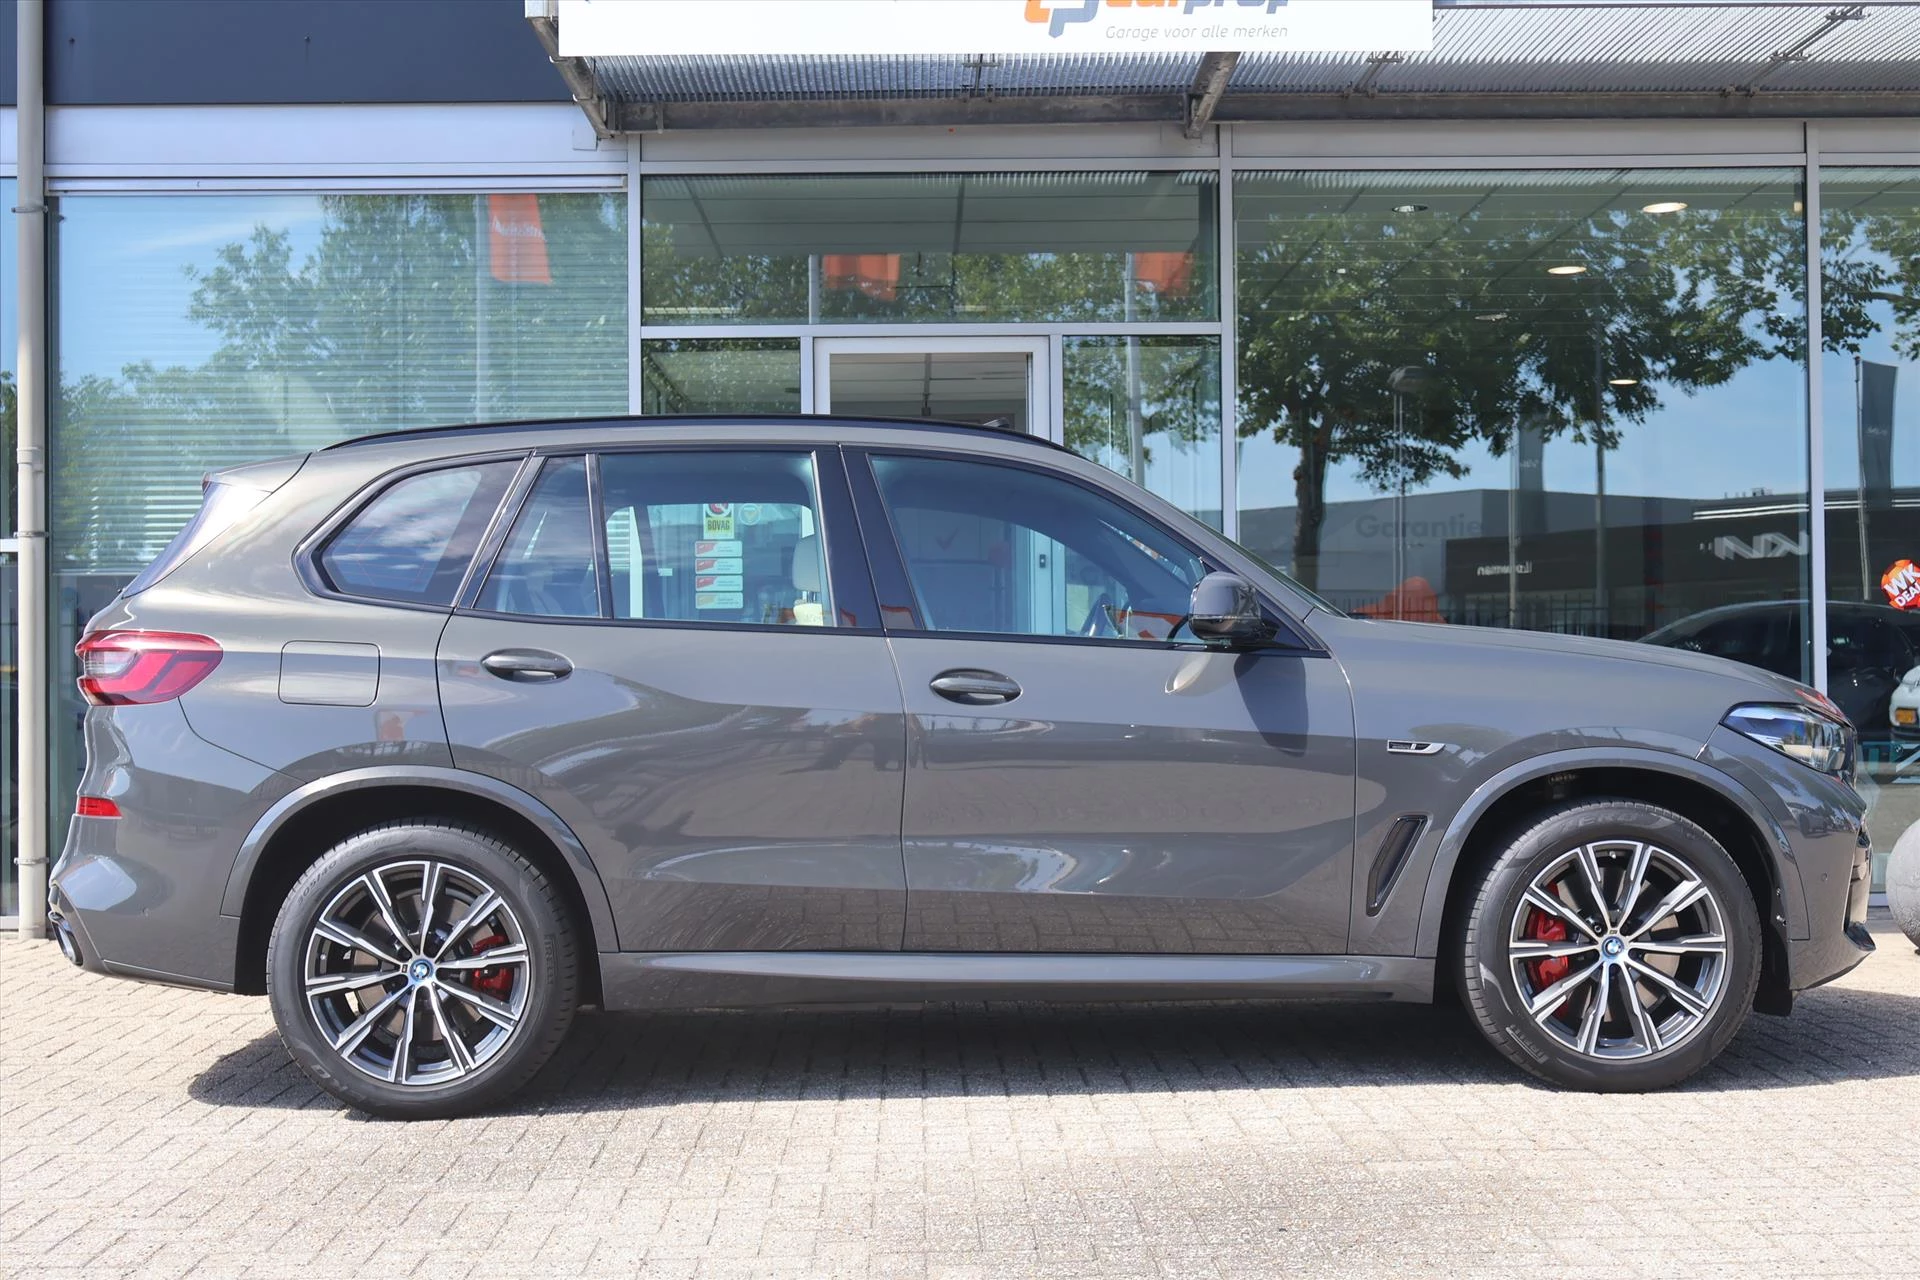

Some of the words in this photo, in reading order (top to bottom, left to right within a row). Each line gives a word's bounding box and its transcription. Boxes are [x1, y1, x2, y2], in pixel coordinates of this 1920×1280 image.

[1105, 25, 1159, 42] Garage
[1164, 27, 1197, 39] voor
[1201, 25, 1229, 39] alle
[1233, 25, 1289, 39] merken
[707, 519, 731, 532] BOVAG
[1354, 512, 1484, 539] Garantie
[1883, 562, 1920, 596] WK
